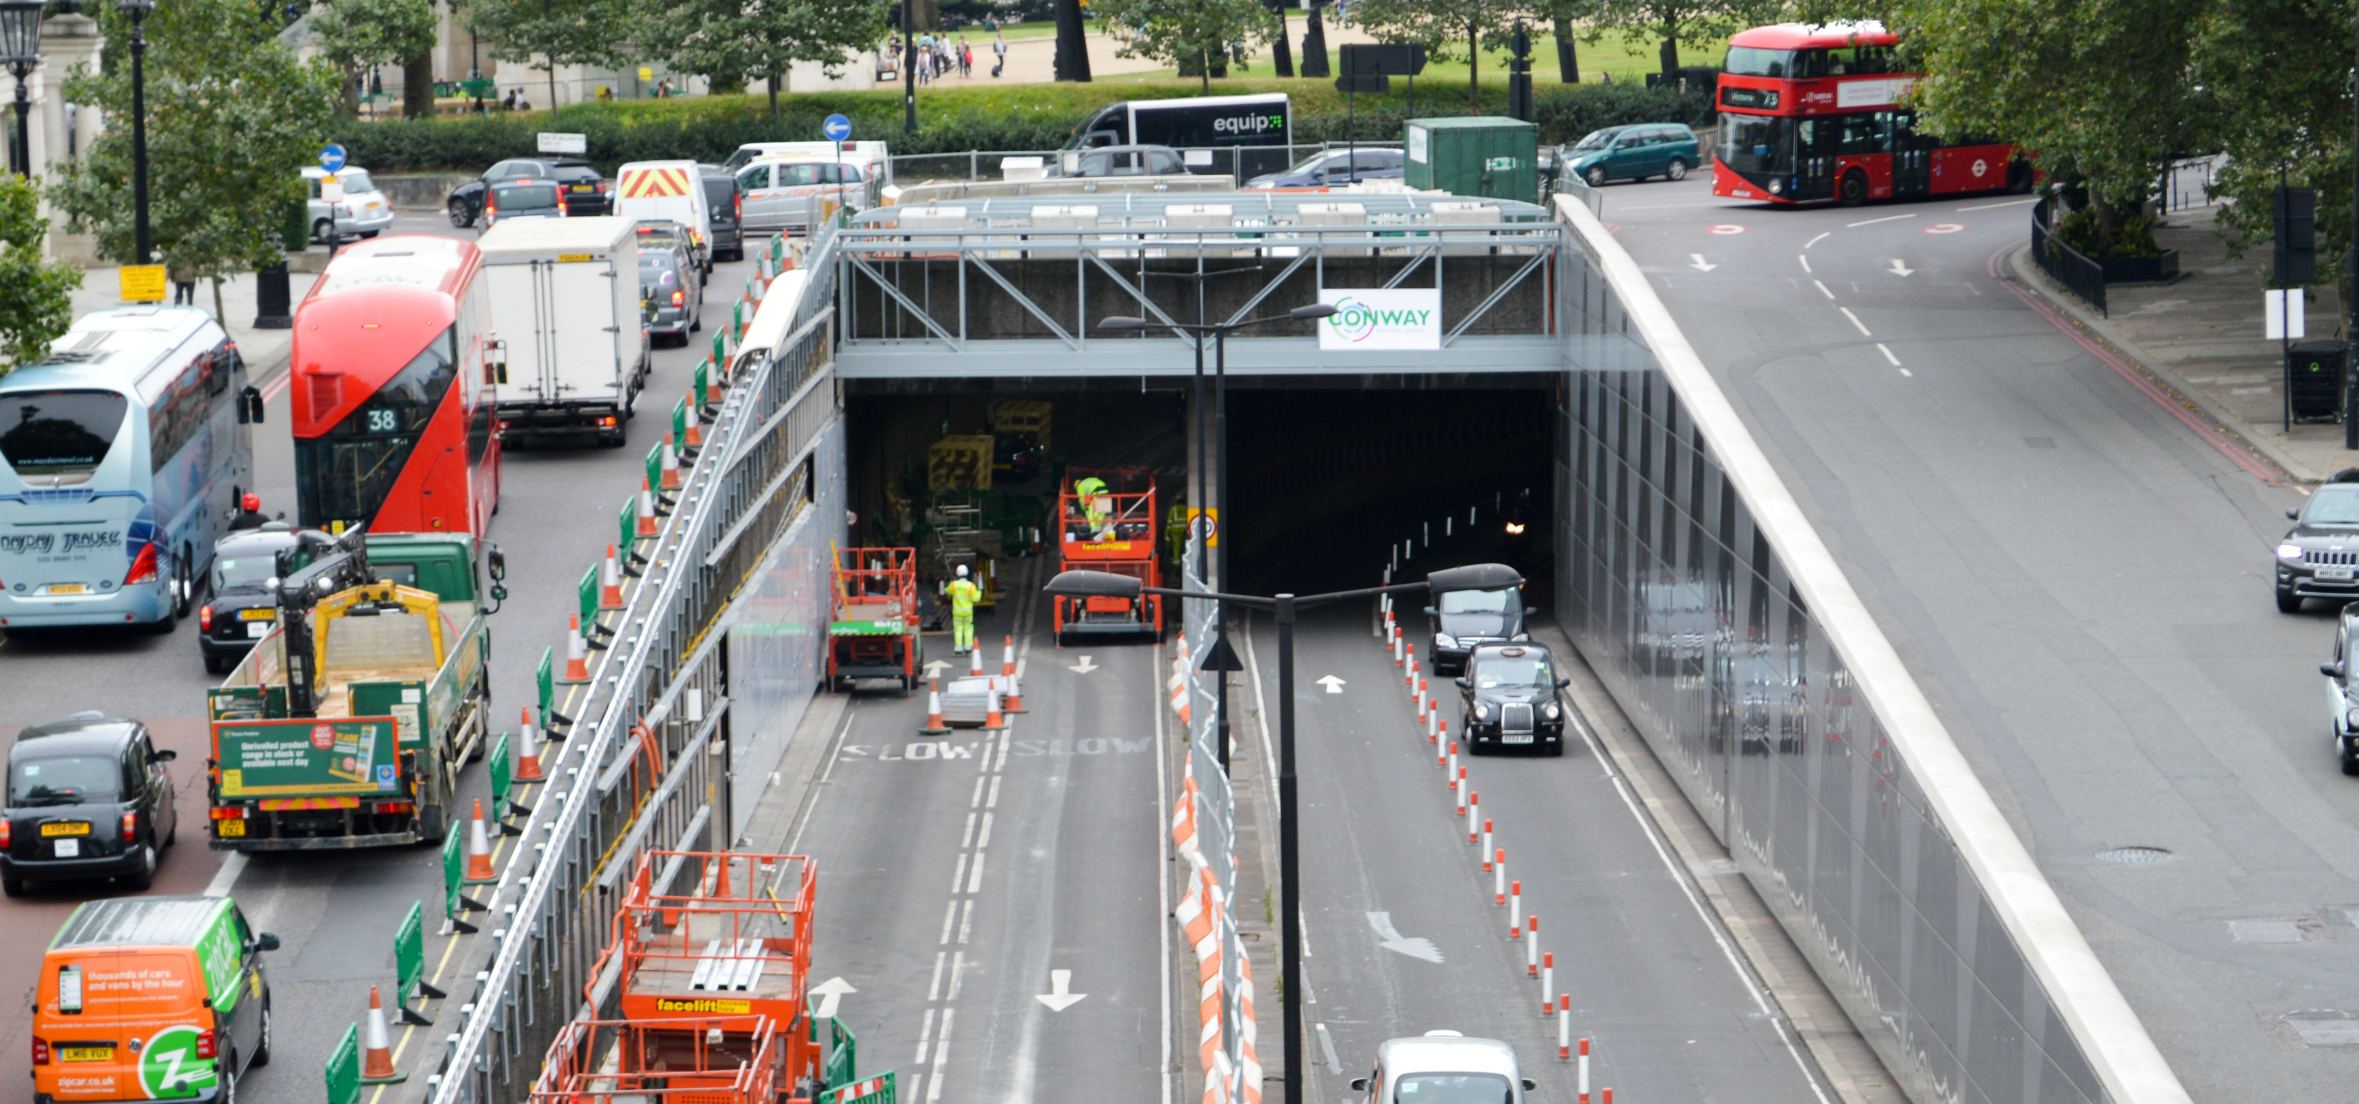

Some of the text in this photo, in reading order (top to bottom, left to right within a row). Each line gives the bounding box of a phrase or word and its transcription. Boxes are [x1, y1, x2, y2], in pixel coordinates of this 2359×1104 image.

[1763, 92, 1778, 106] 73
[1213, 112, 1269, 135] equip
[1328, 309, 1431, 326] CONWAY
[368, 409, 396, 431] 38
[241, 742, 279, 751] Unrivalled
[280, 740, 309, 750] product
[839, 741, 979, 762] SLOW
[1013, 736, 1153, 757] SLOW
[242, 749, 305, 761] range in stock or
[242, 758, 309, 768] available next day
[88, 969, 171, 981] thousands of cars
[88, 977, 185, 991] and vans by the hour
[656, 998, 718, 1012] facelift
[65, 1047, 109, 1060] LM16 VUX
[58, 1075, 115, 1088] zipcar.co.uk
